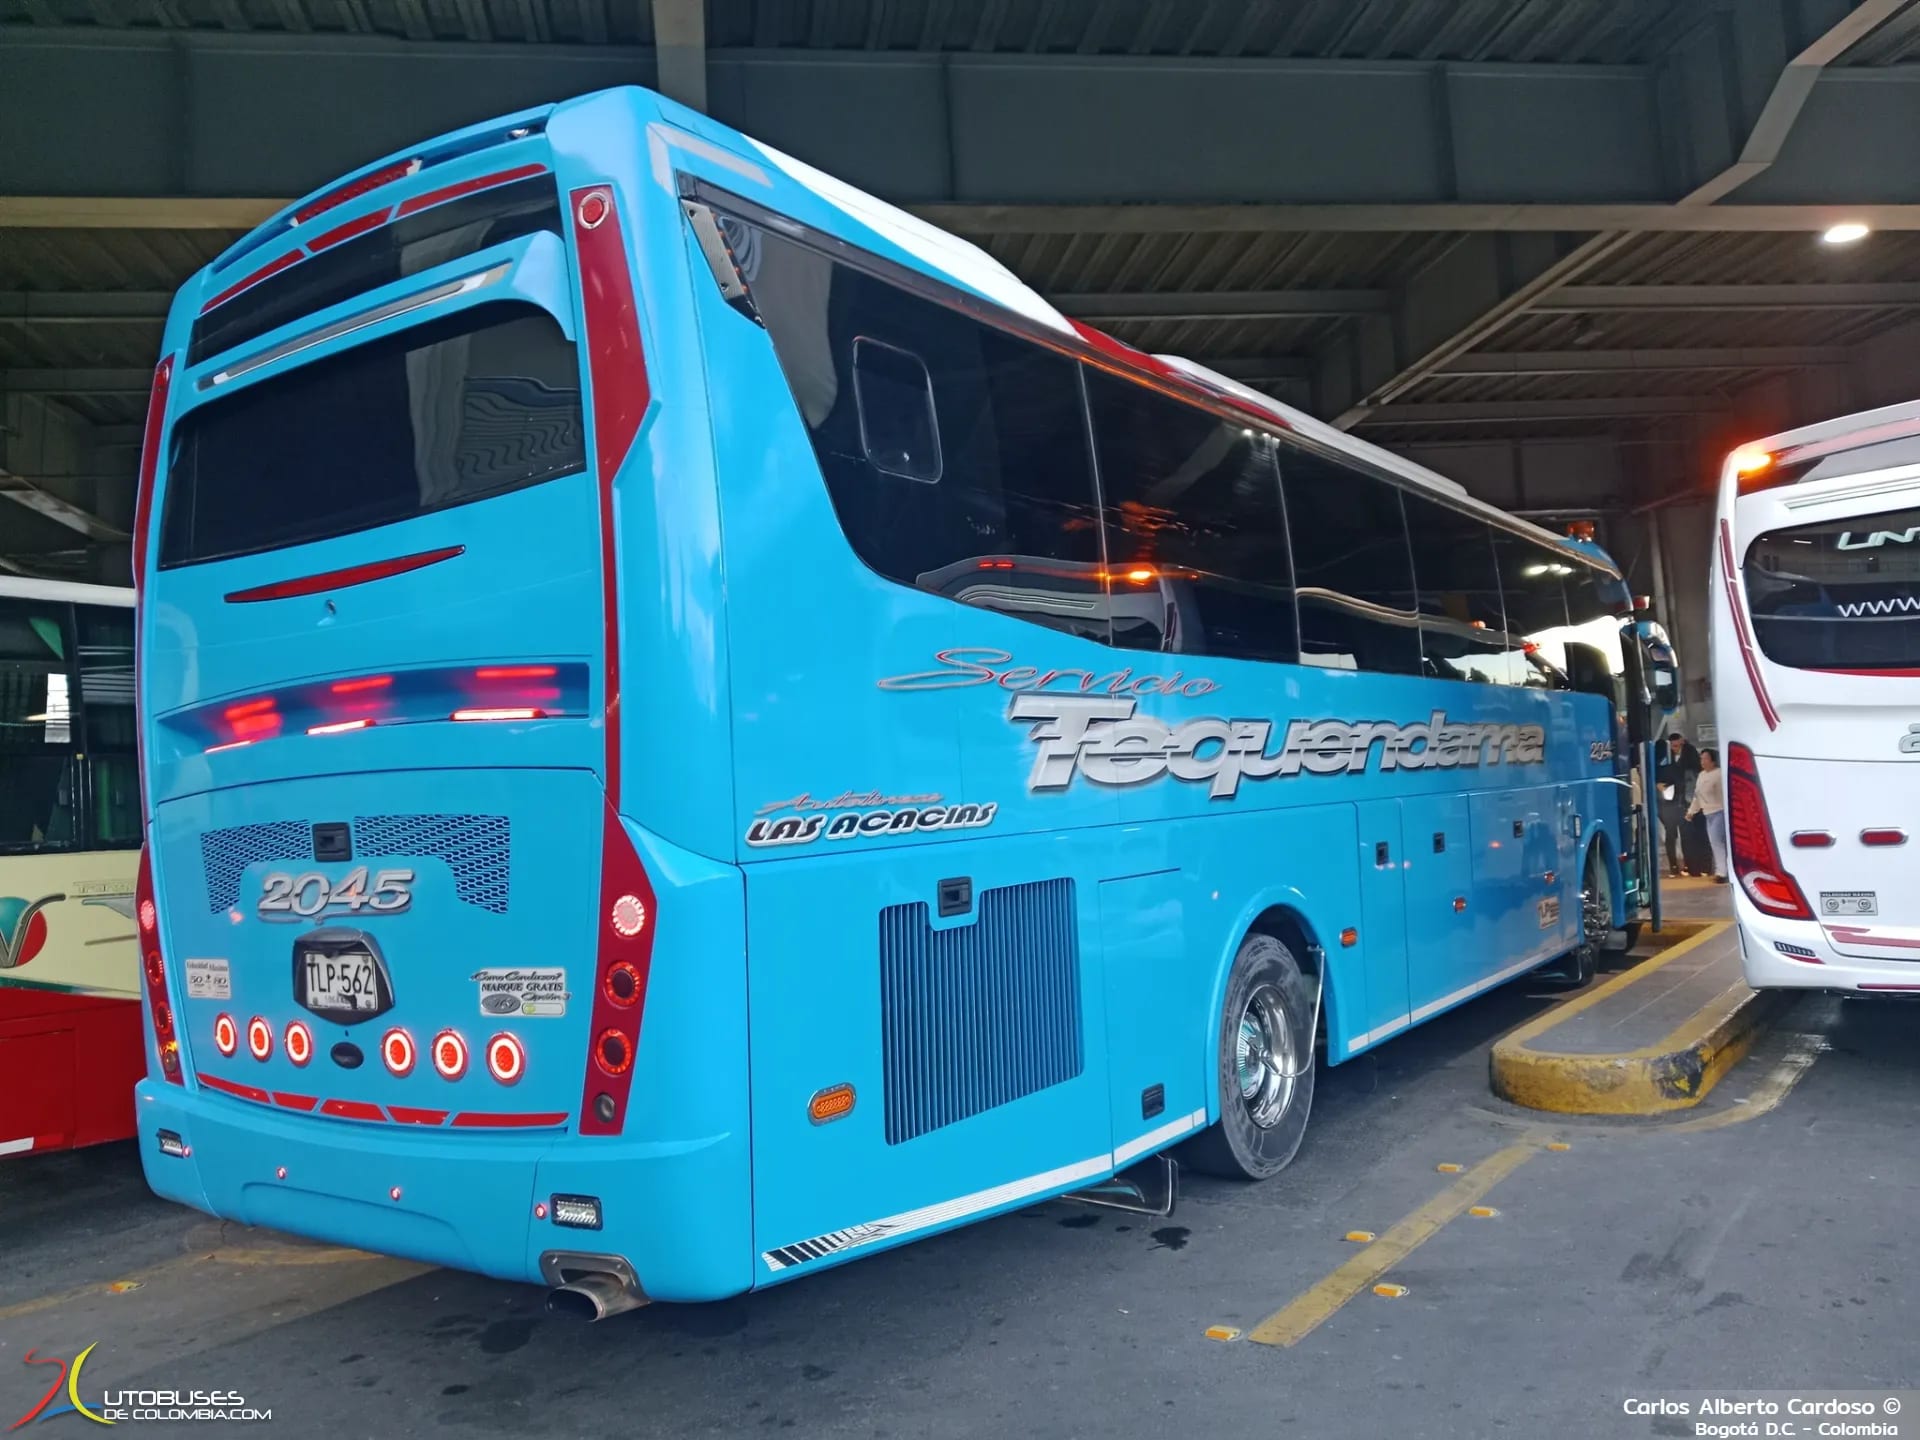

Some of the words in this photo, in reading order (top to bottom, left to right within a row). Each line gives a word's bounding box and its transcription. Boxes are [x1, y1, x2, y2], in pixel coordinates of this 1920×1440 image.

[877, 648, 1222, 697] Servicio
[1007, 690, 1545, 800] Tequendama
[746, 815, 827, 846] LAS
[826, 803, 997, 839] ACACIAS
[258, 866, 415, 916] 2045
[482, 982, 522, 992] MARQUE
[526, 982, 563, 991] GRATIS
